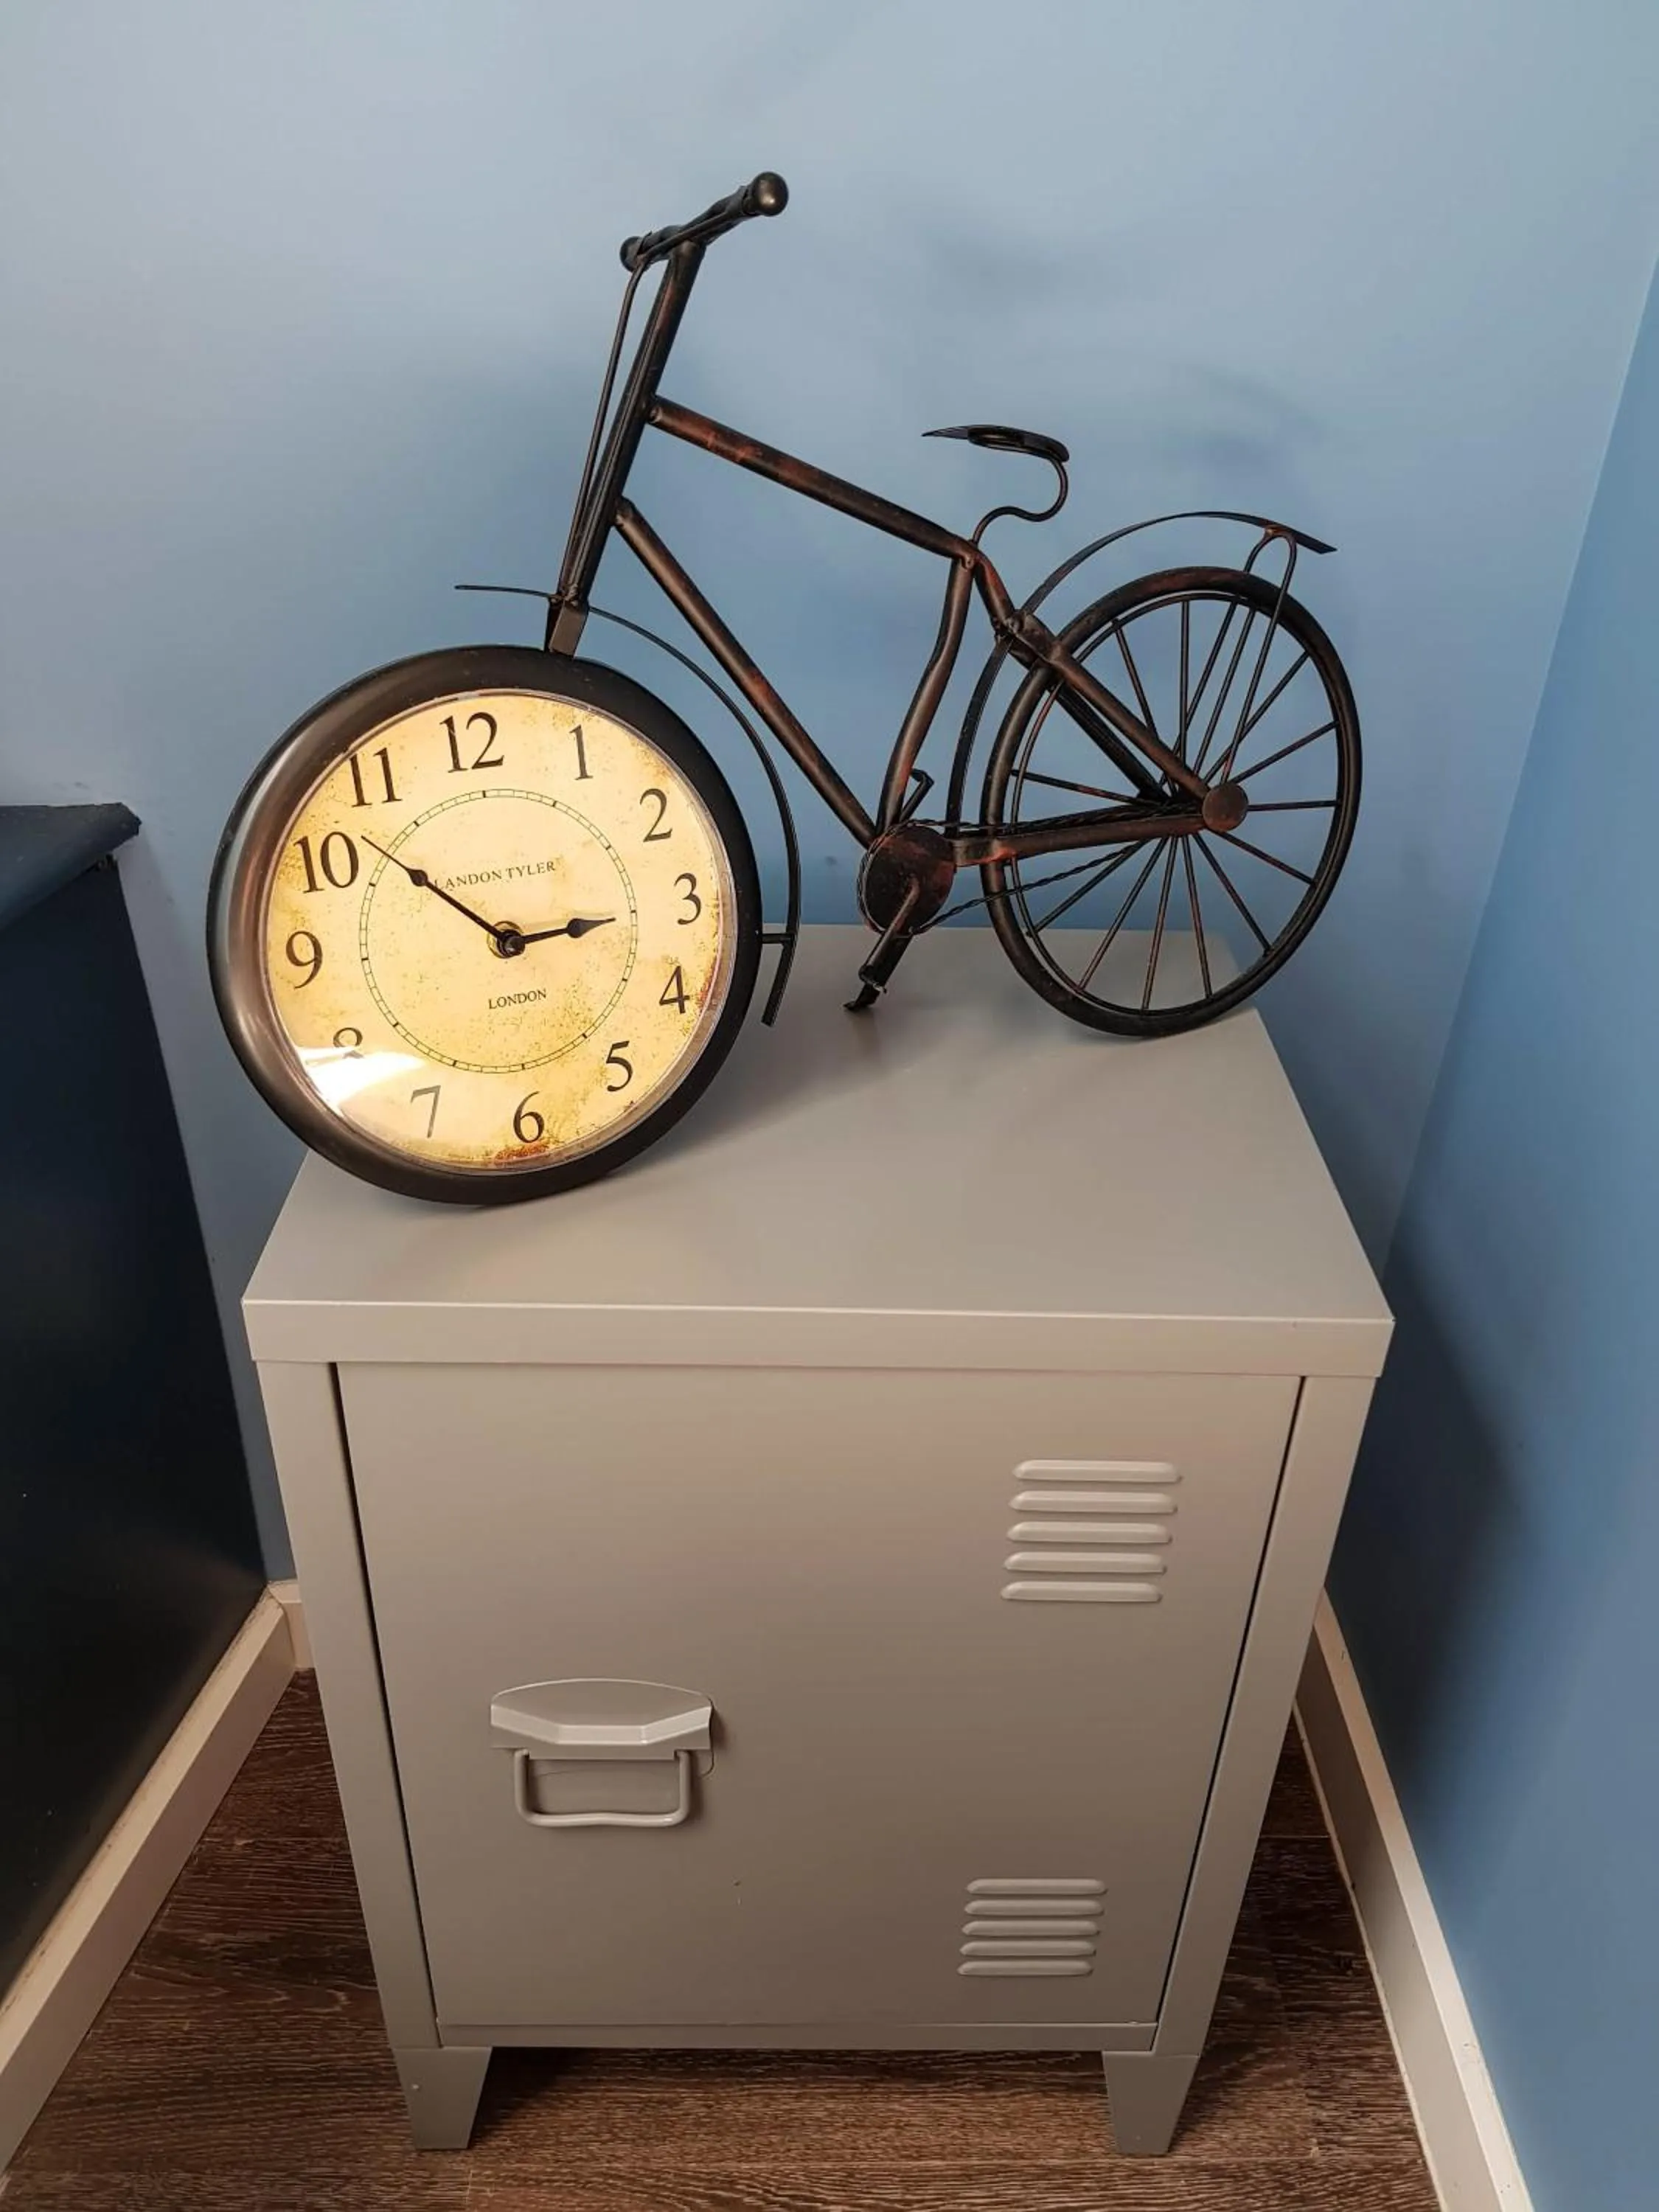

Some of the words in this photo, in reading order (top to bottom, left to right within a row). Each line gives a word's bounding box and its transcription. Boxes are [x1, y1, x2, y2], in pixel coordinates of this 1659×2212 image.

[439, 712, 505, 773] 12
[568, 724, 594, 780] 1
[347, 747, 403, 807] 11
[639, 787, 672, 842] 2
[293, 831, 360, 894] 10
[505, 860, 556, 880] TYLER
[673, 872, 701, 925] 3
[285, 931, 323, 989] 9
[488, 988, 547, 1010] LONDON
[658, 965, 690, 1014] 4
[605, 1040, 634, 1091] 5
[411, 1085, 441, 1138] 7
[512, 1091, 545, 1144] 6
